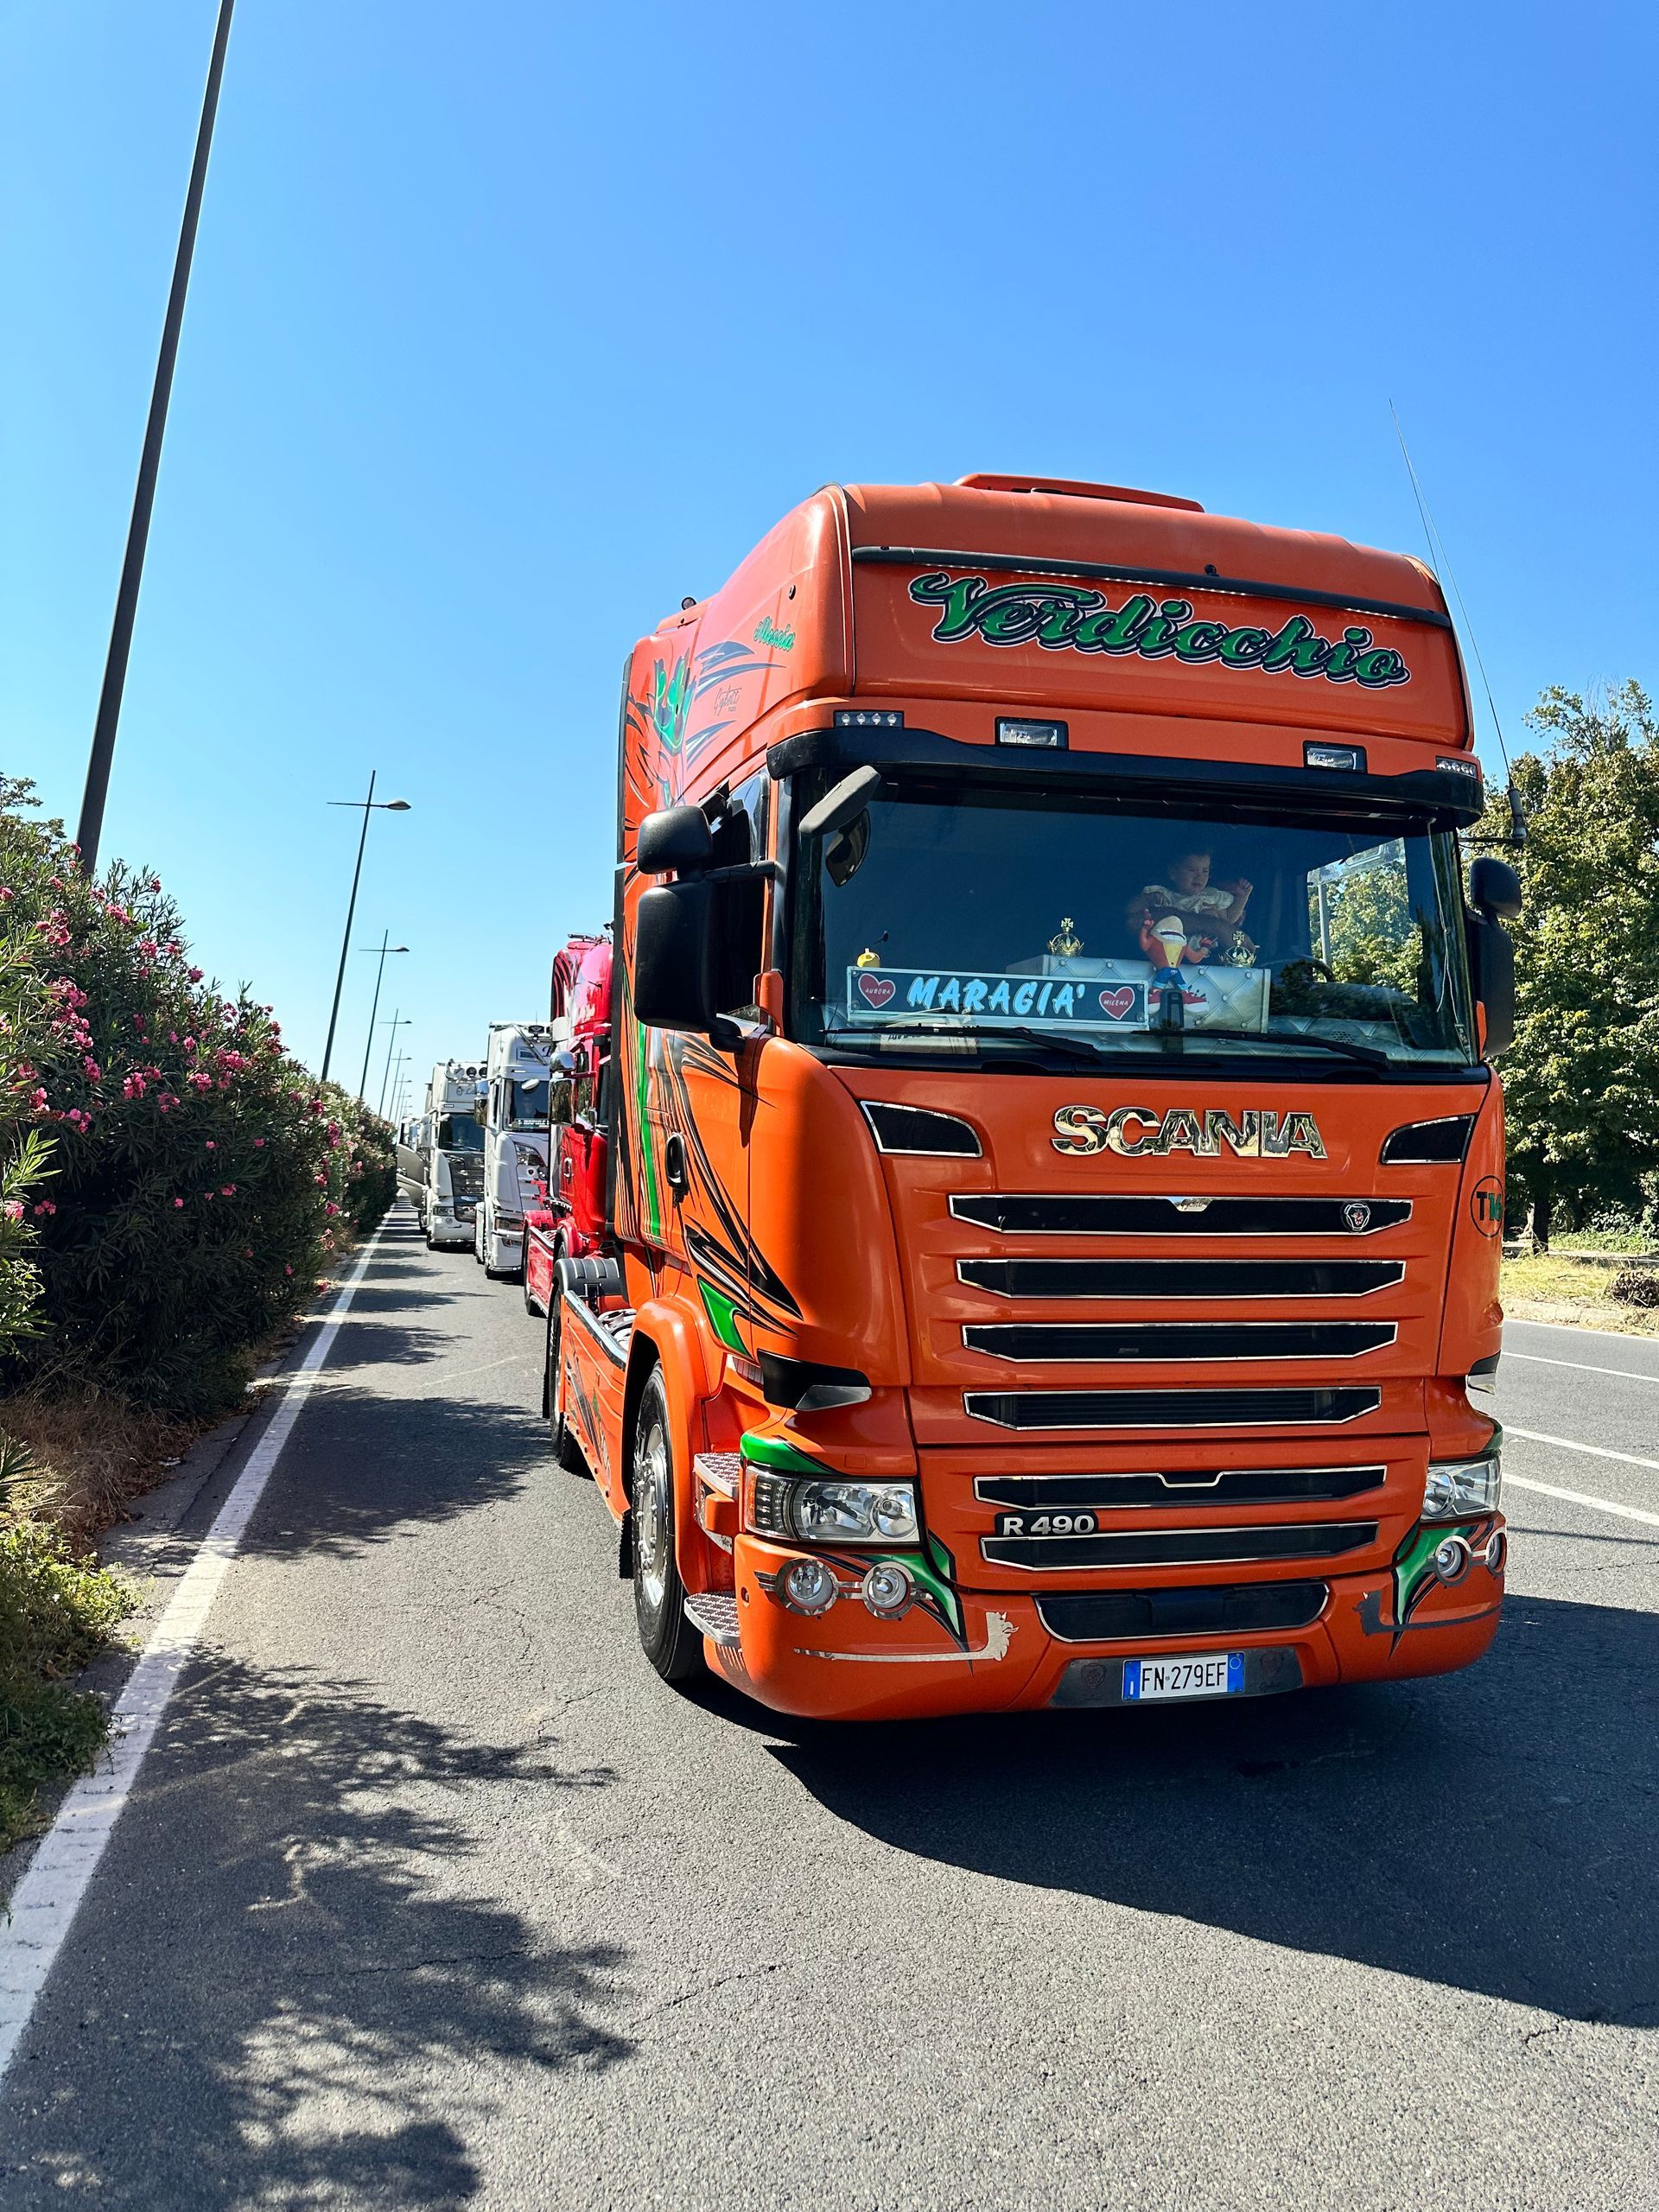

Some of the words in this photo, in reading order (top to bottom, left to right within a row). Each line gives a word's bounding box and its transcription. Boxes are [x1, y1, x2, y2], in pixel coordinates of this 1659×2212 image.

[908, 571, 1411, 690] Verdicchio
[1051, 1104, 1328, 1159] SCANIA
[1002, 1516, 1024, 1535] R
[1030, 1515, 1095, 1535] 490
